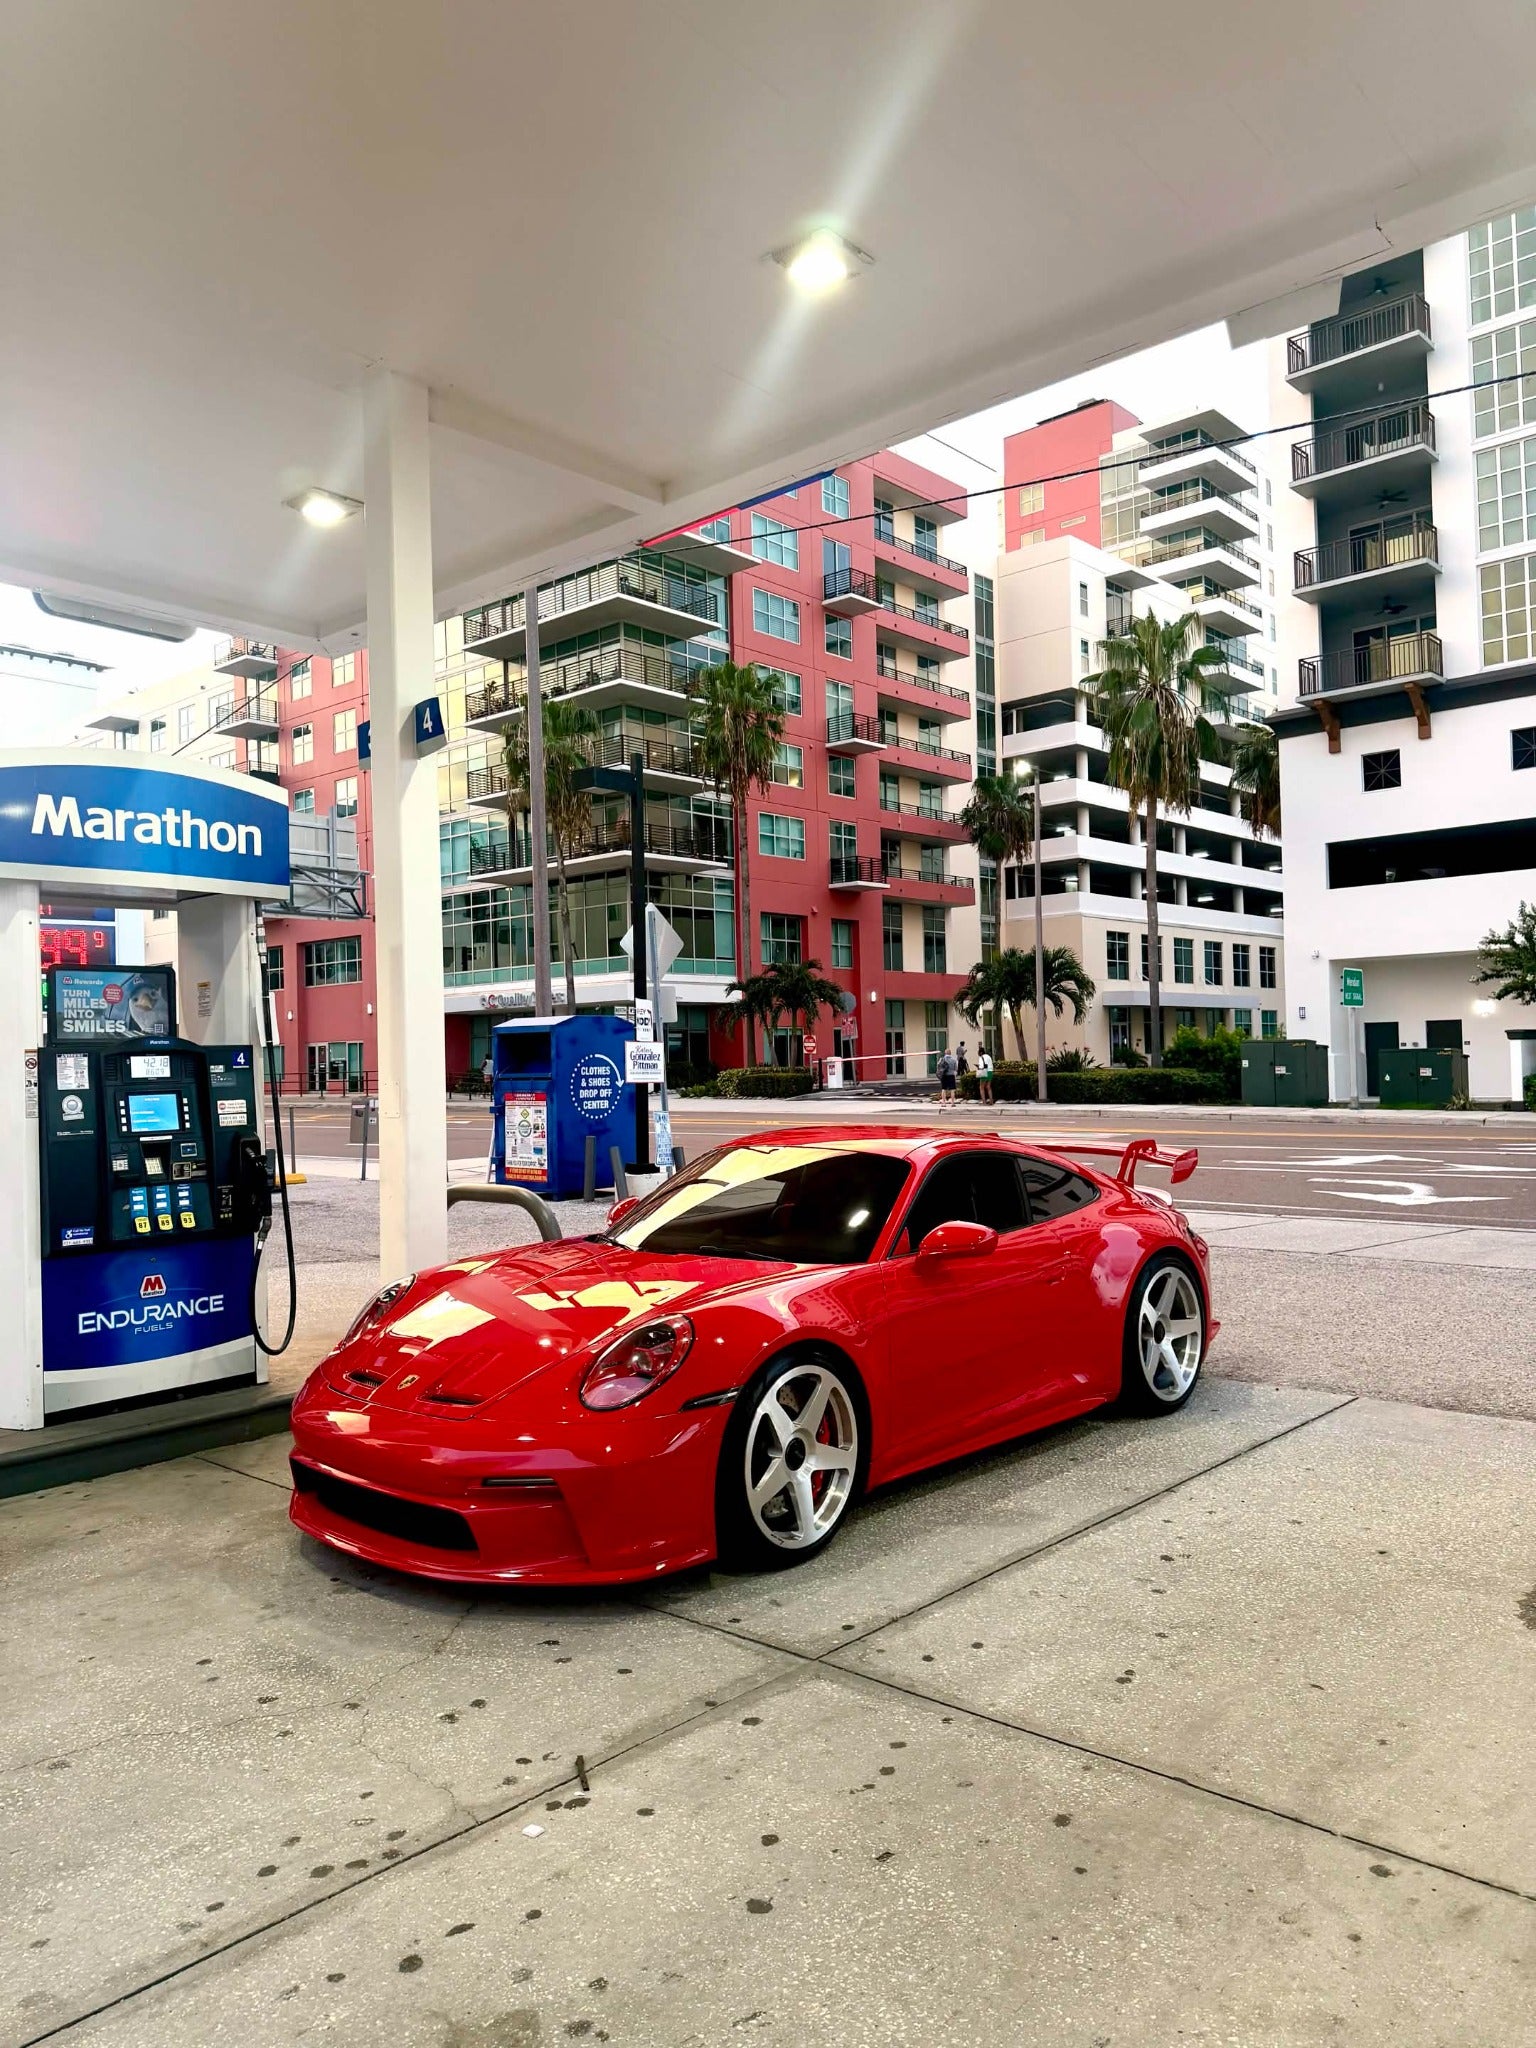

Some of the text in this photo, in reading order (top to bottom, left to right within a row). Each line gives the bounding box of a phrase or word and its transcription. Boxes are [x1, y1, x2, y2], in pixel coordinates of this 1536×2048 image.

[423, 707, 433, 733] 4
[31, 793, 262, 857] Marathon
[63, 989, 90, 997] TURN
[63, 998, 108, 1009] MILES
[63, 1009, 95, 1019] INTO
[63, 1020, 126, 1033] SMILES
[237, 1052, 245, 1065] 4
[630, 1051, 661, 1061] Gonzalez
[632, 1061, 658, 1070] Pittman
[580, 1066, 611, 1076] CLOTHES
[580, 1078, 611, 1087] & SHOES
[579, 1088, 613, 1098] DROP OFF
[583, 1100, 609, 1110] CENTER
[138, 1221, 147, 1229] 87
[143, 1276, 164, 1292] M
[78, 1294, 224, 1334] ENDURANCE
[134, 1321, 174, 1335] FUELS
